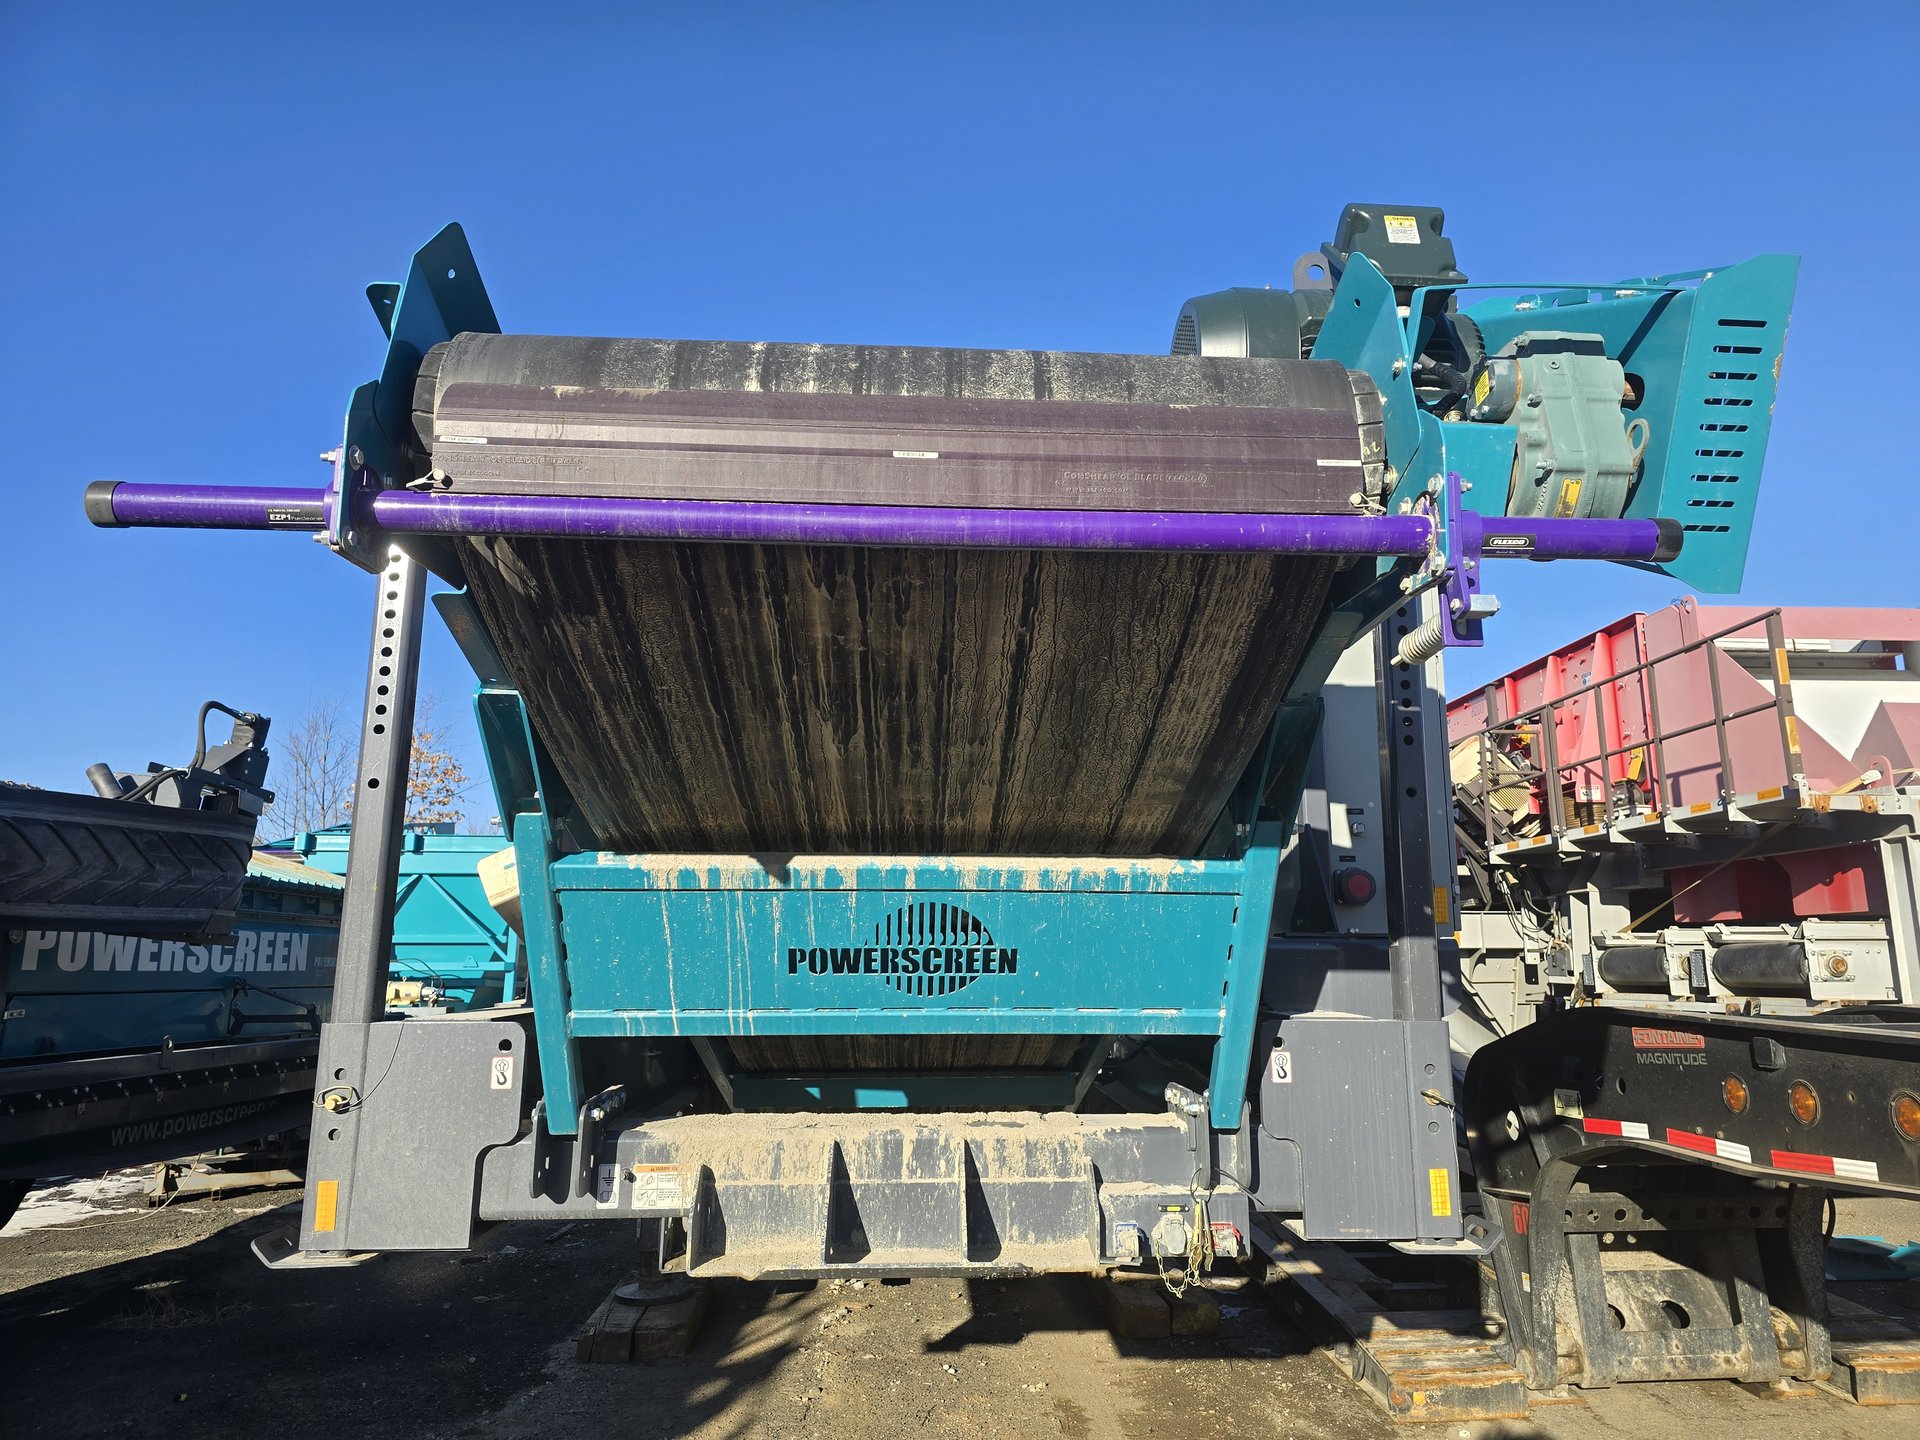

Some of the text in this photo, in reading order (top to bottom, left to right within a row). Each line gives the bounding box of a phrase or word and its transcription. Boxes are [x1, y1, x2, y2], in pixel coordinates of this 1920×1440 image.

[21, 930, 309, 972] POWERSCREEN
[788, 947, 1018, 975] POWERSCREEN
[1635, 1030, 1700, 1045] FONTAINE
[1636, 1052, 1708, 1066] MAGNITUDE
